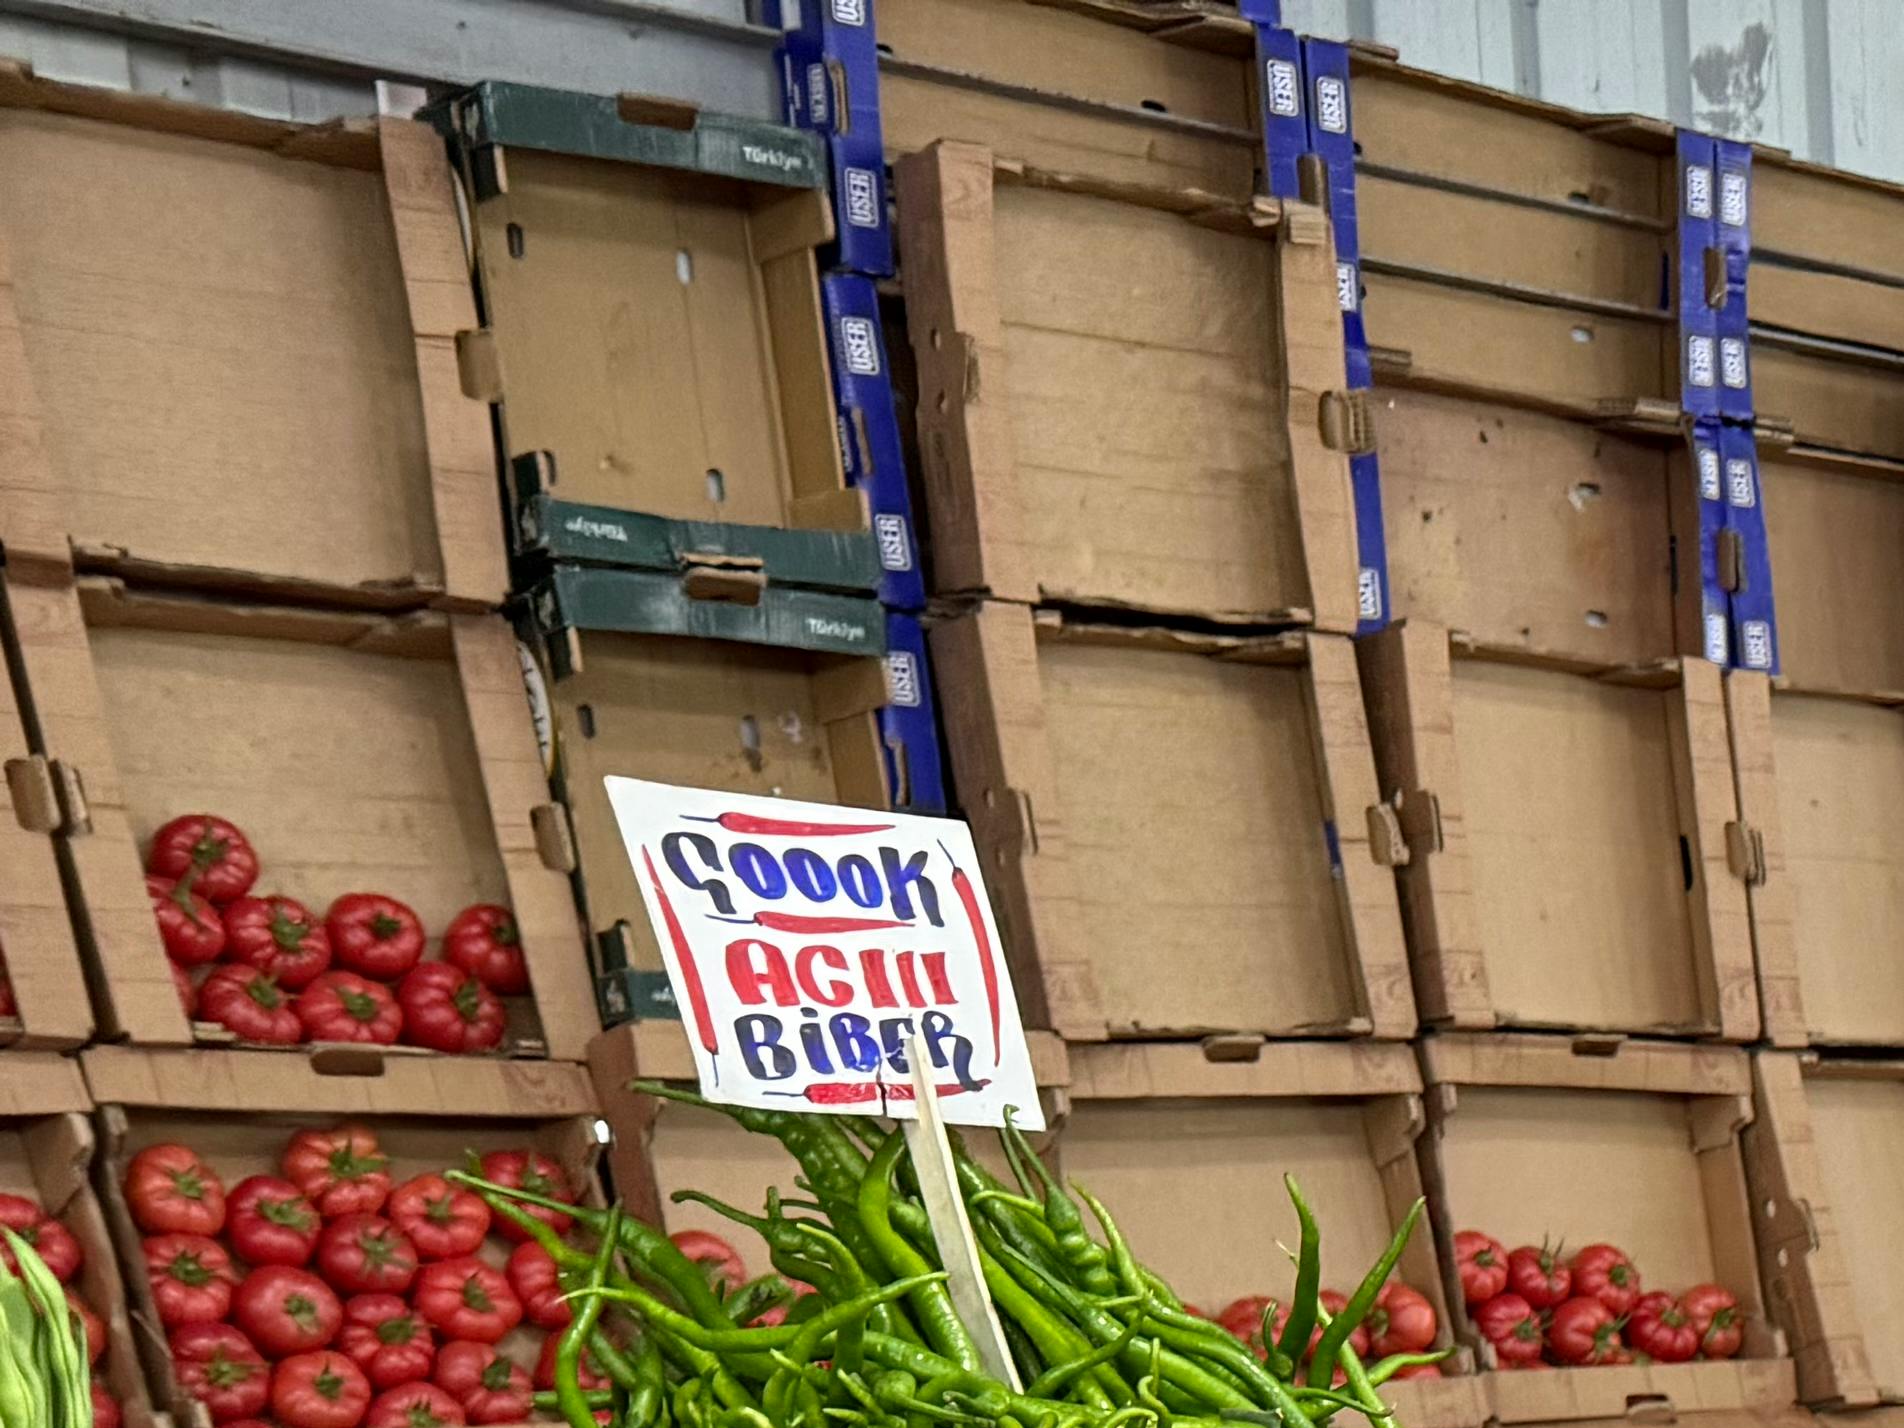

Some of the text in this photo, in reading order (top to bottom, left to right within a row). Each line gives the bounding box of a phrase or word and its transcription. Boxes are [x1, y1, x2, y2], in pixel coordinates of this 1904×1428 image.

[1270, 63, 1297, 114] USER
[1319, 80, 1344, 131] USER
[850, 172, 872, 223] USER
[846, 323, 878, 372] USER
[879, 518, 909, 567] USER
[1746, 624, 1770, 666] USER
[893, 655, 919, 704] USER
